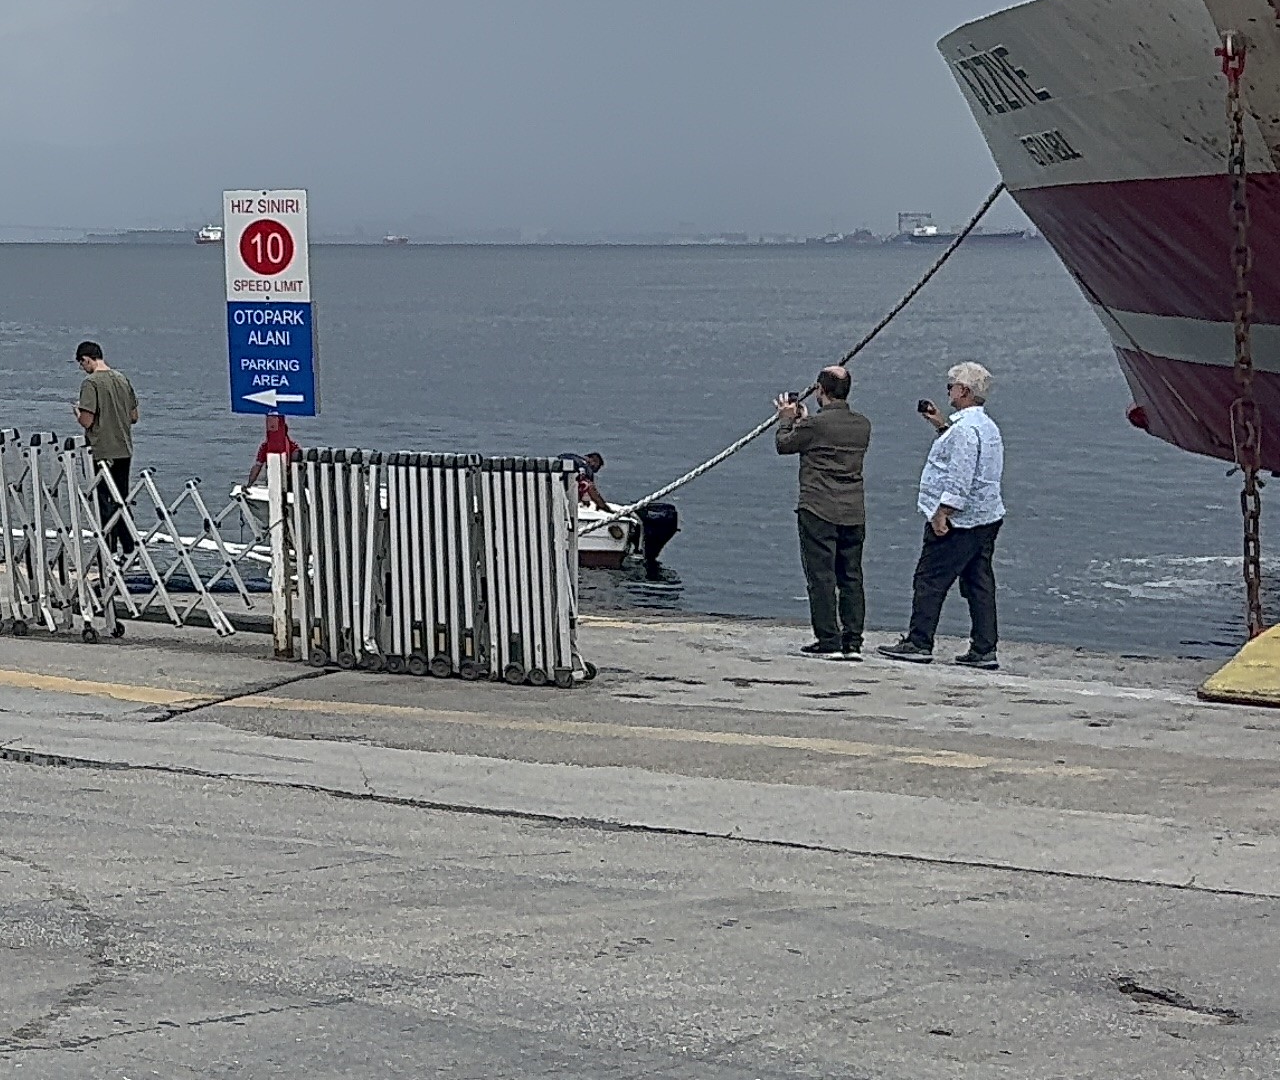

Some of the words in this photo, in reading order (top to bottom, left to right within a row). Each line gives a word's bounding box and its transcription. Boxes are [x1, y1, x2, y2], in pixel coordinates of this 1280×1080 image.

[231, 199, 253, 214] HIZ
[257, 199, 300, 214] SINIRI
[250, 232, 284, 264] 10
[233, 280, 271, 292] SPEED
[274, 280, 303, 293] LIMIT
[233, 310, 304, 325] OTOPARK
[248, 330, 290, 346] ALANI
[240, 359, 300, 372] PARKING
[251, 375, 290, 387] AREA
